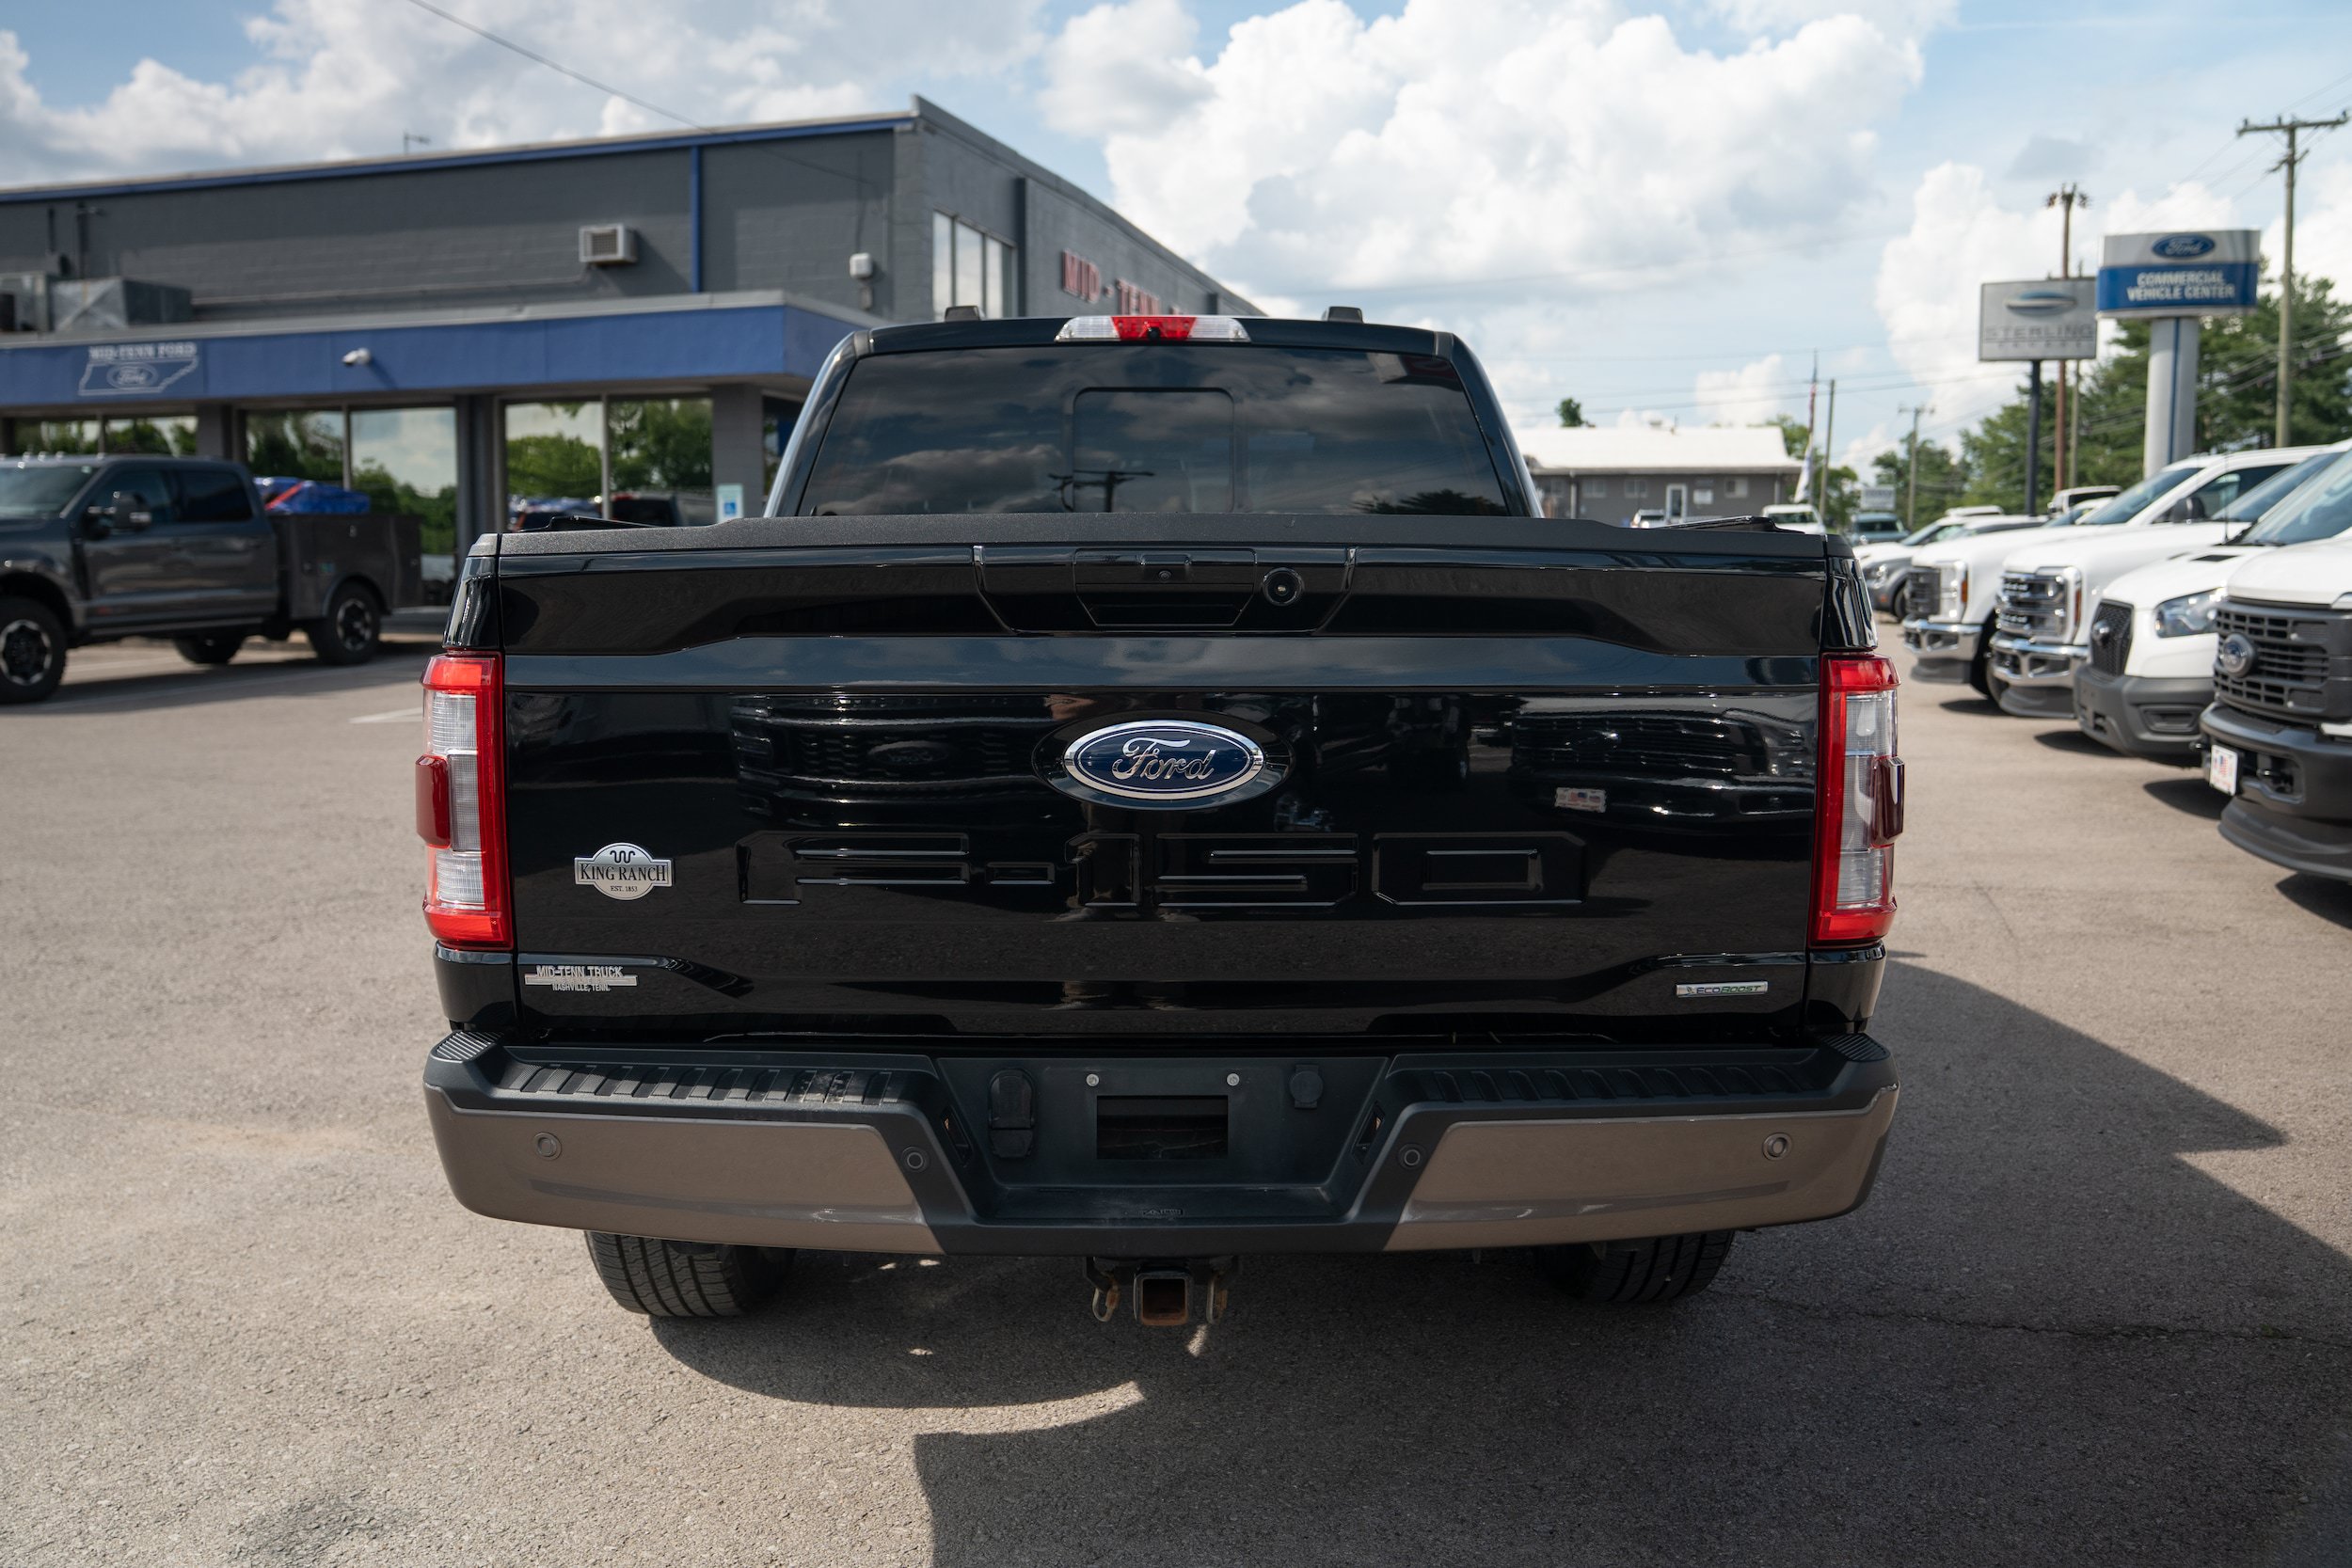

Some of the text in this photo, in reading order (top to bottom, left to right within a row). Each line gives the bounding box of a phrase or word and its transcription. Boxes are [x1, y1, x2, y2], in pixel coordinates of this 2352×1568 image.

[2165, 238, 2204, 256] Ford
[2137, 270, 2224, 286] COMMERCIAL
[2126, 283, 2235, 301] VEHICLE CENTER
[157, 341, 198, 357] FORD
[1111, 736, 1216, 780] Ford
[580, 863, 666, 881] KING RANCH
[736, 832, 1586, 907] F-150
[536, 965, 624, 978] MID-TENN TRUCK
[552, 983, 612, 992] NASHVILLE, TENN.
